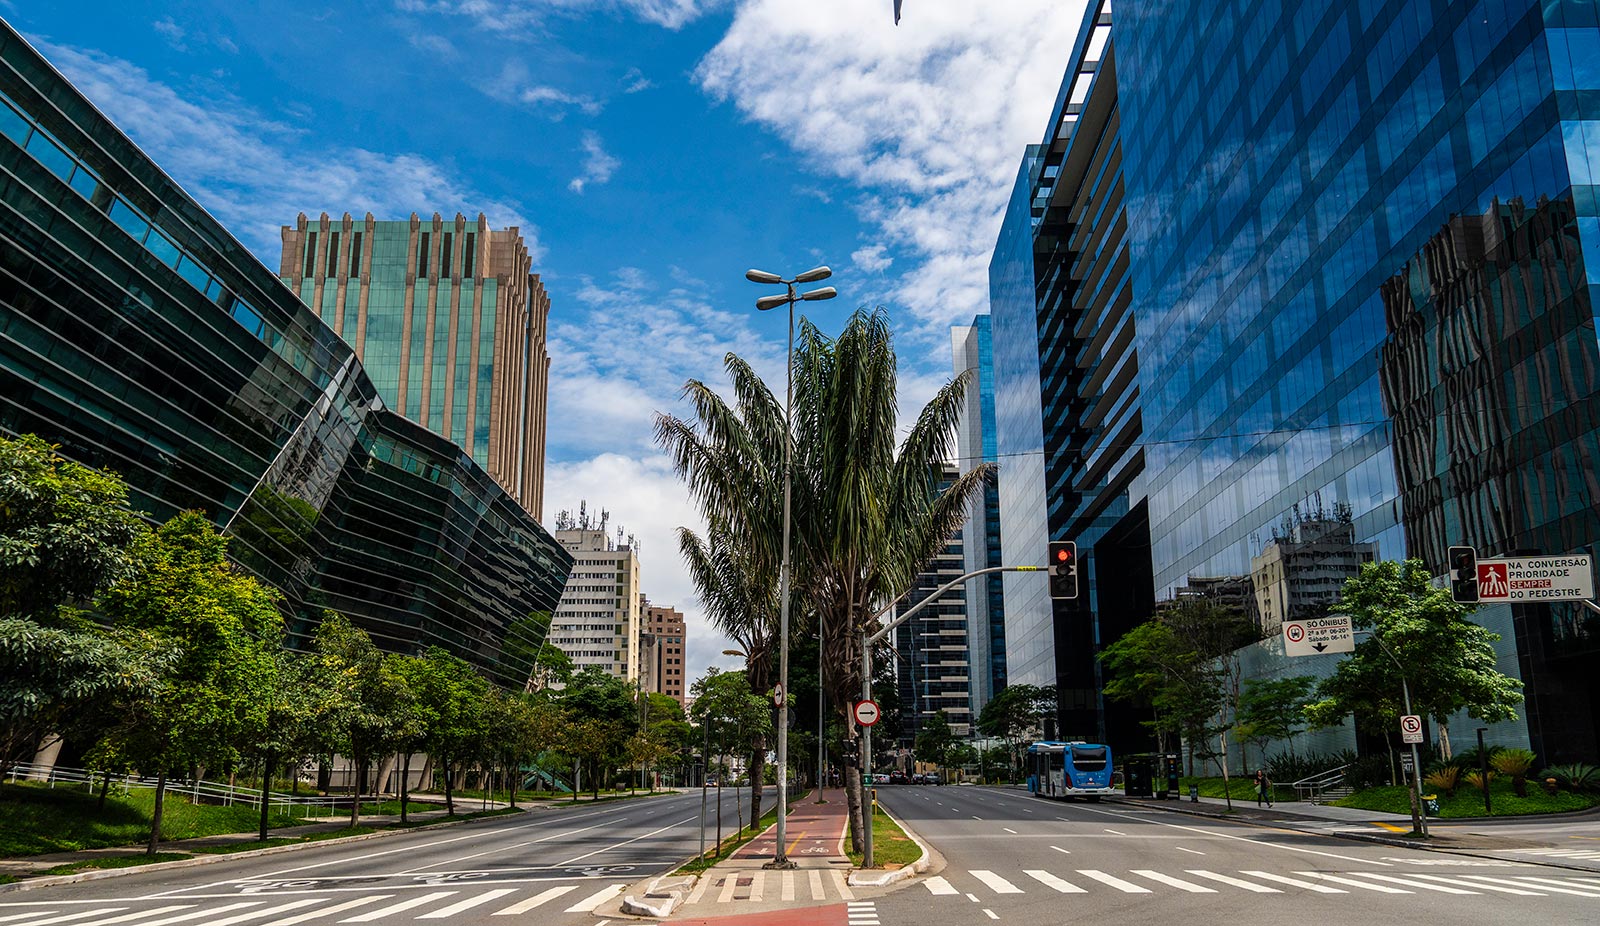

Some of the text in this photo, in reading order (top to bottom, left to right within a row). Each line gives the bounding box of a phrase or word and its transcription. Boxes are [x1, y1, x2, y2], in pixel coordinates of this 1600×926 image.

[1508, 558, 1588, 570] NA CONVERSÃO
[1509, 569, 1570, 579] PRIORIDADE
[1510, 580, 1551, 589] SEMPRE
[1510, 588, 1581, 599] DO PEDESTRE
[1319, 618, 1348, 627] ÔNIBUS
